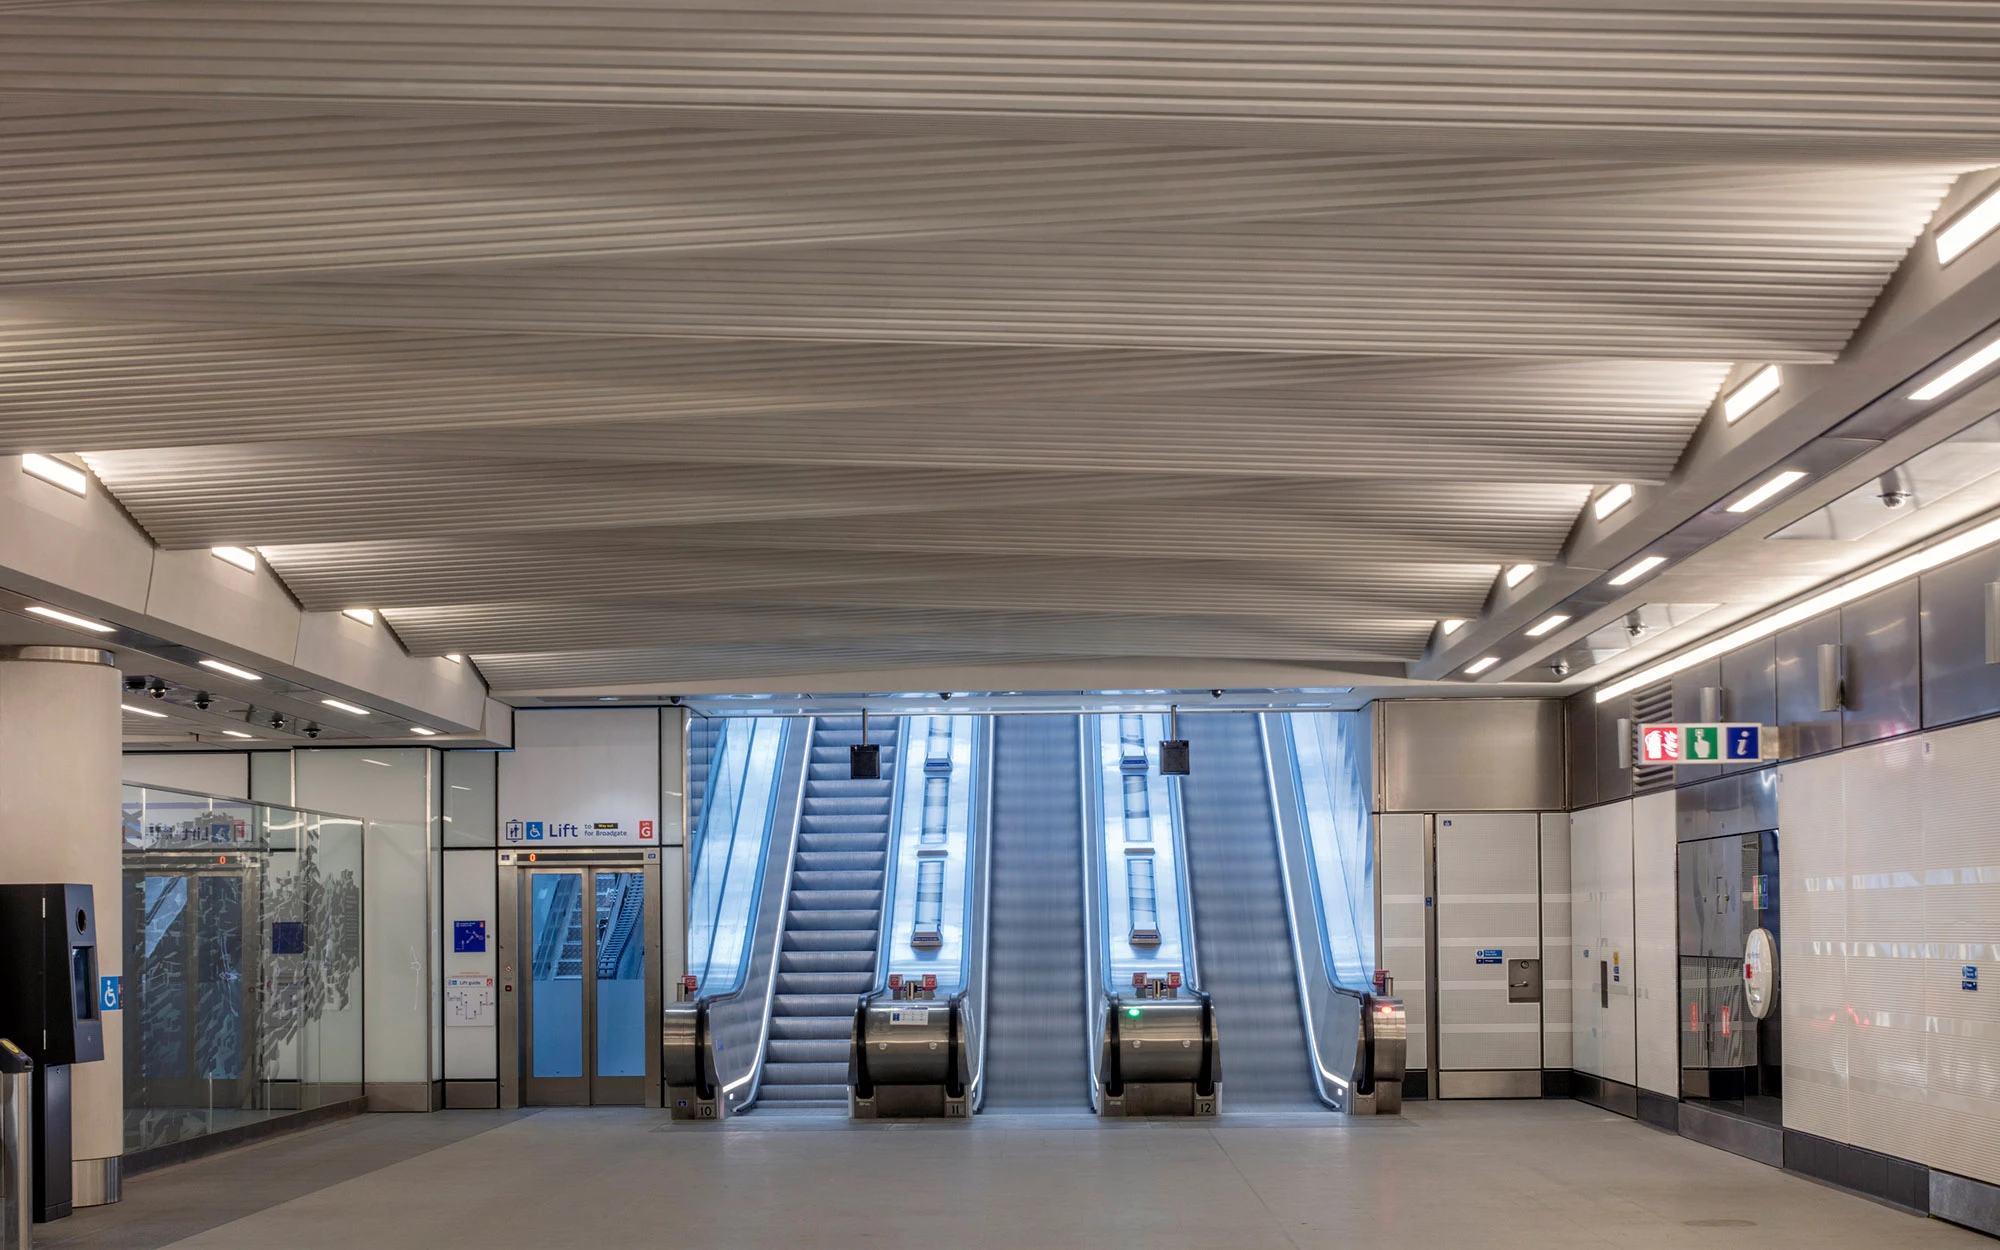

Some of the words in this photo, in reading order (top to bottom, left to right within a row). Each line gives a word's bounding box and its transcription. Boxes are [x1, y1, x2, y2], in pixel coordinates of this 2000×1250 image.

[549, 823, 578, 838] Lift
[641, 826, 651, 837] G
[529, 852, 536, 863] 0
[700, 1106, 712, 1116] 10
[952, 1105, 959, 1115] 11
[1200, 1103, 1211, 1113] 12
